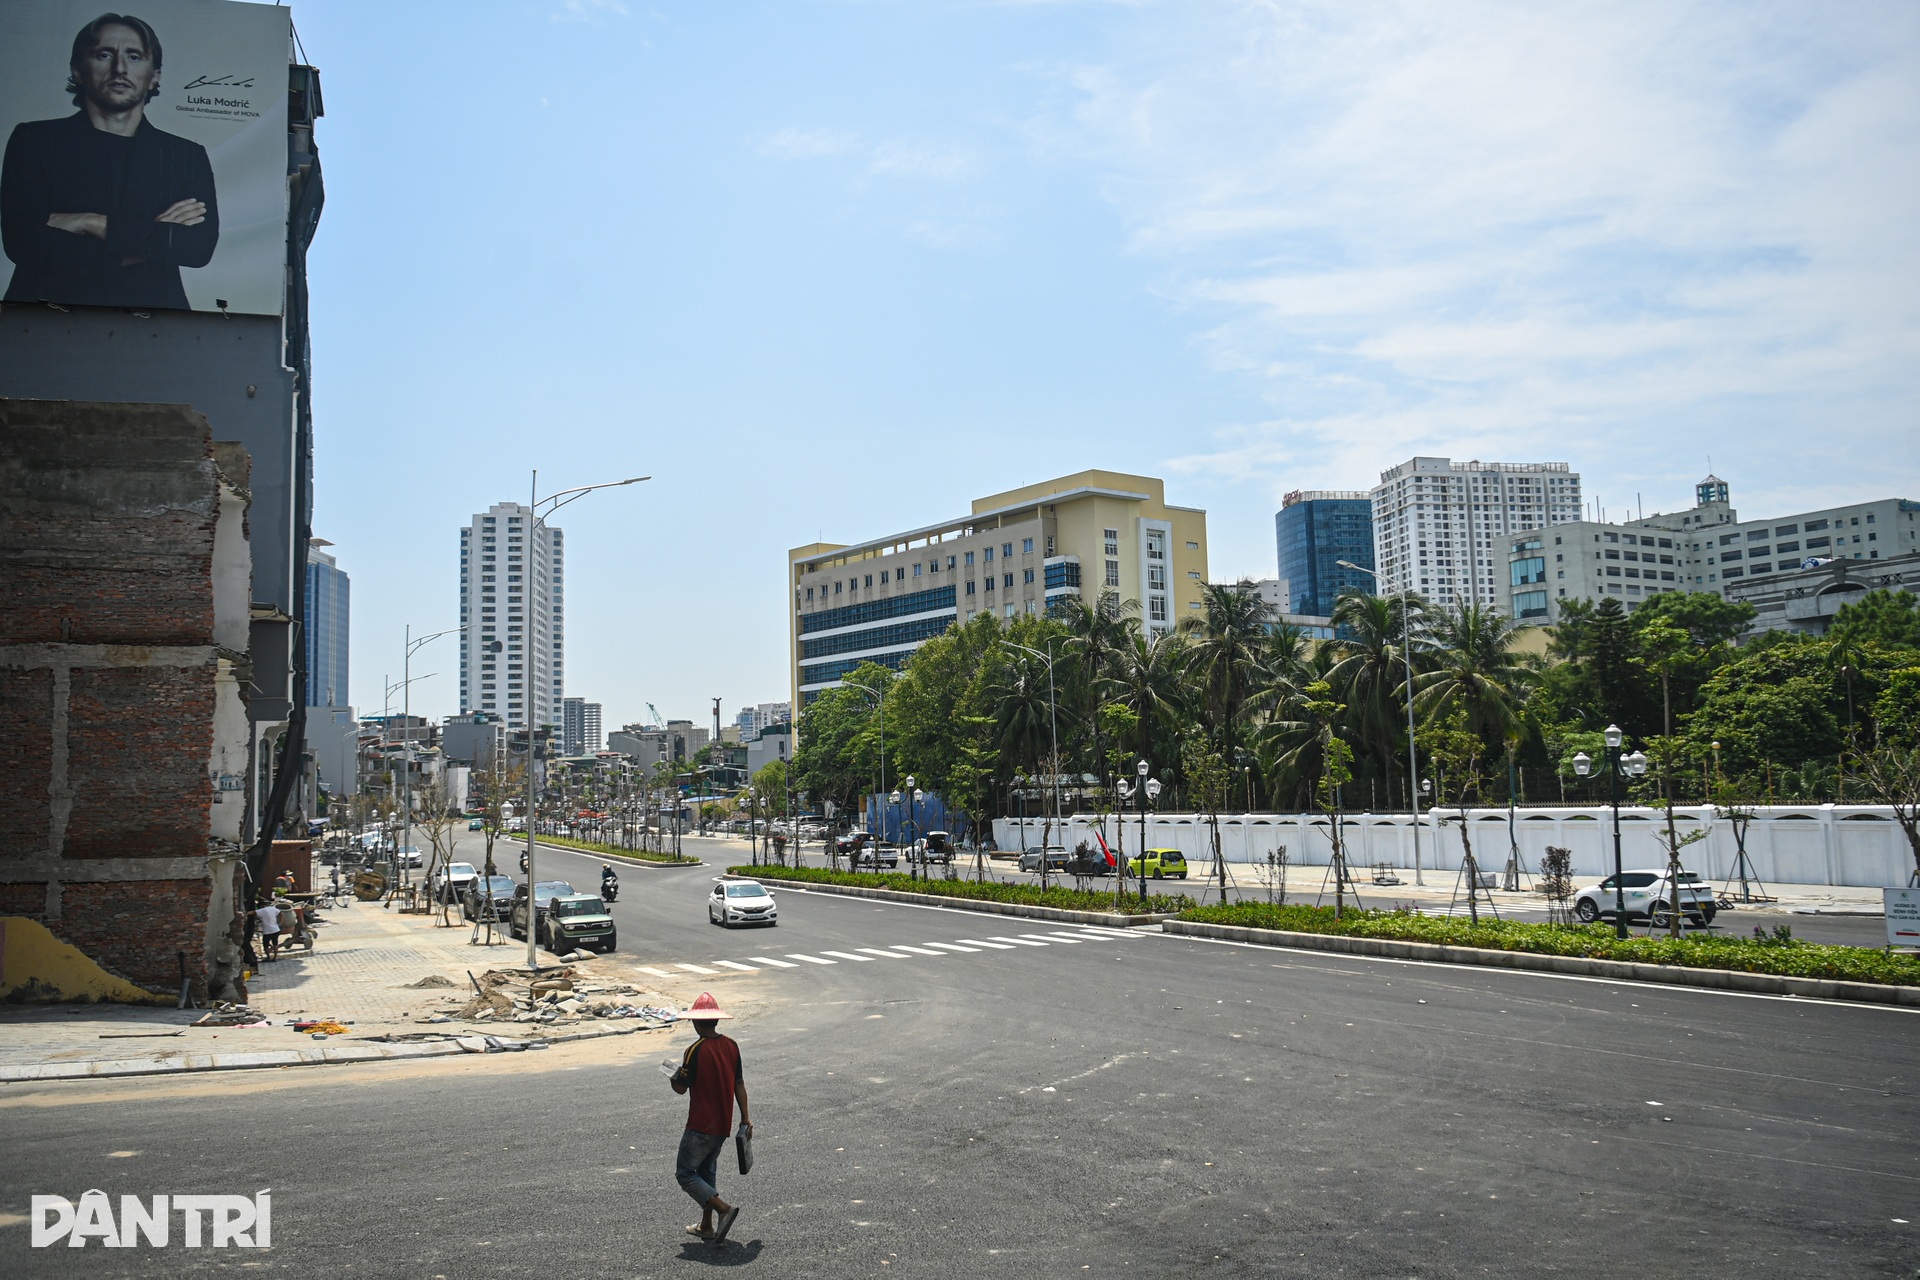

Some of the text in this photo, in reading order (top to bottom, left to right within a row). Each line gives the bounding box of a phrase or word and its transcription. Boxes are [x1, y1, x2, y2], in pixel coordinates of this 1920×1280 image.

[187, 95, 250, 108] Luka Modrić
[196, 107, 232, 115] Ambassador
